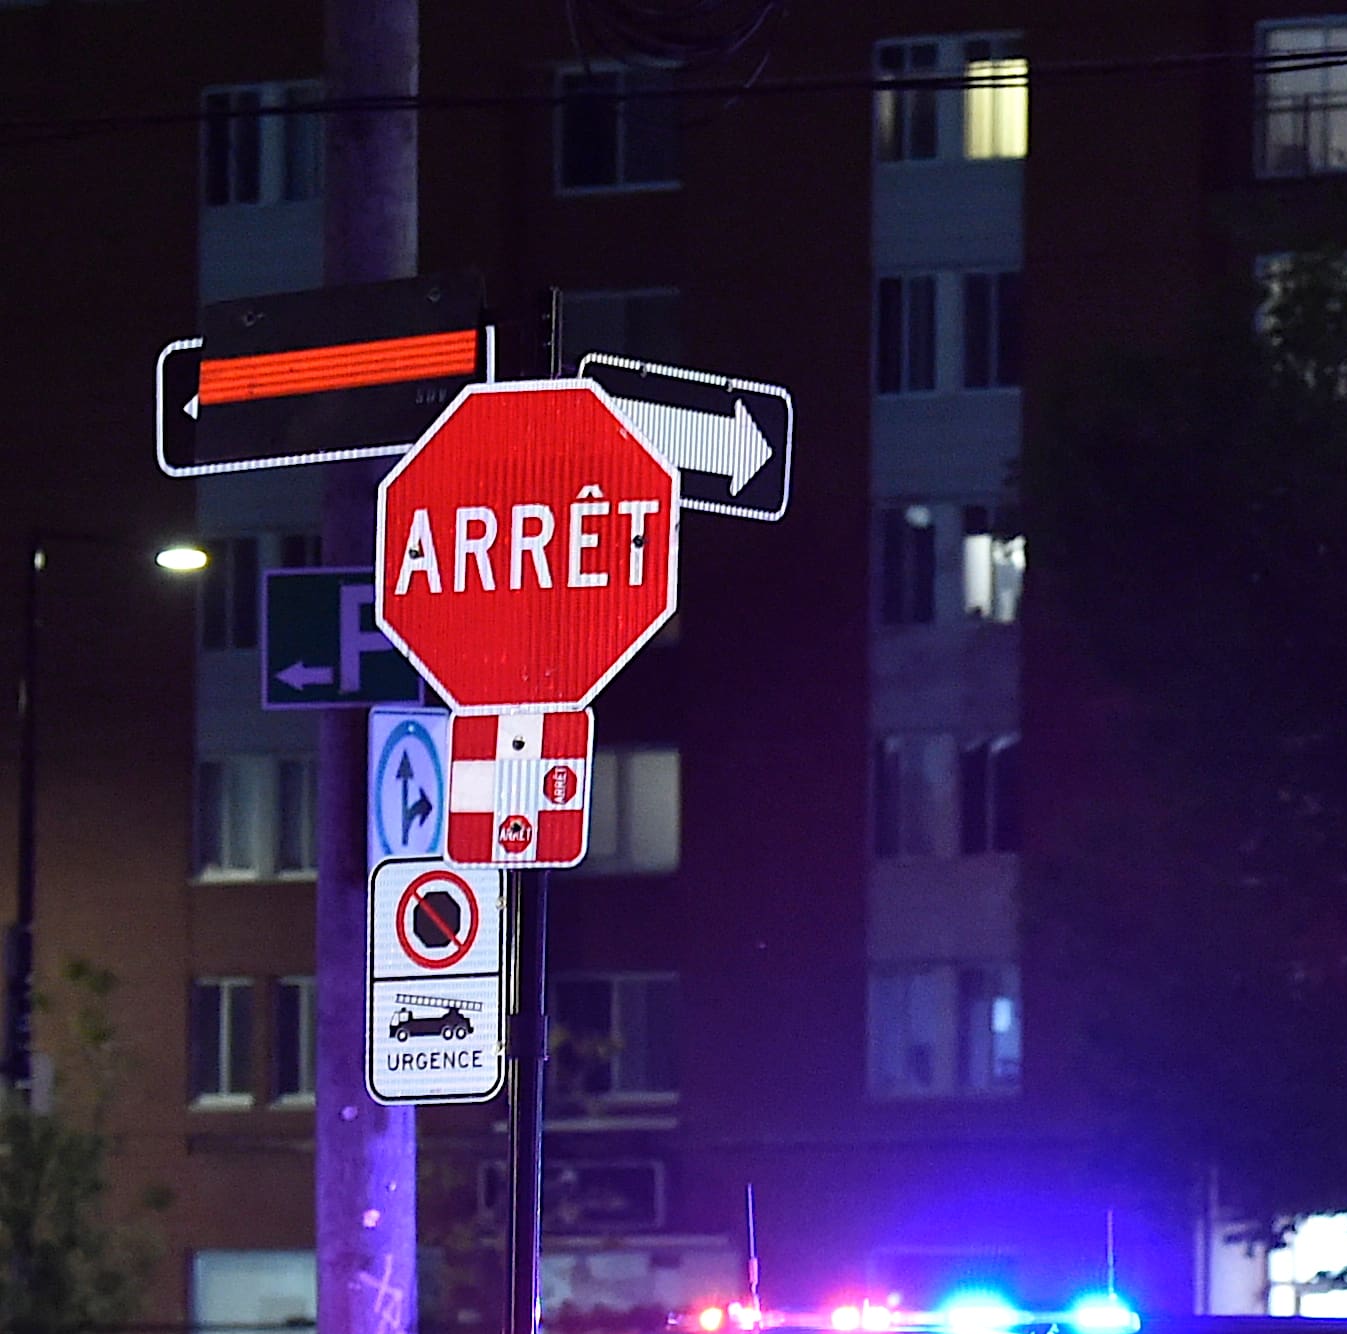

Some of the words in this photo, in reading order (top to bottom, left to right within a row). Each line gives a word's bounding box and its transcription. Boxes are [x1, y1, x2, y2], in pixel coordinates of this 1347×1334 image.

[394, 485, 659, 596] ARRÊT
[553, 766, 567, 805] ARRÊT
[387, 1050, 483, 1071] URGENCE
